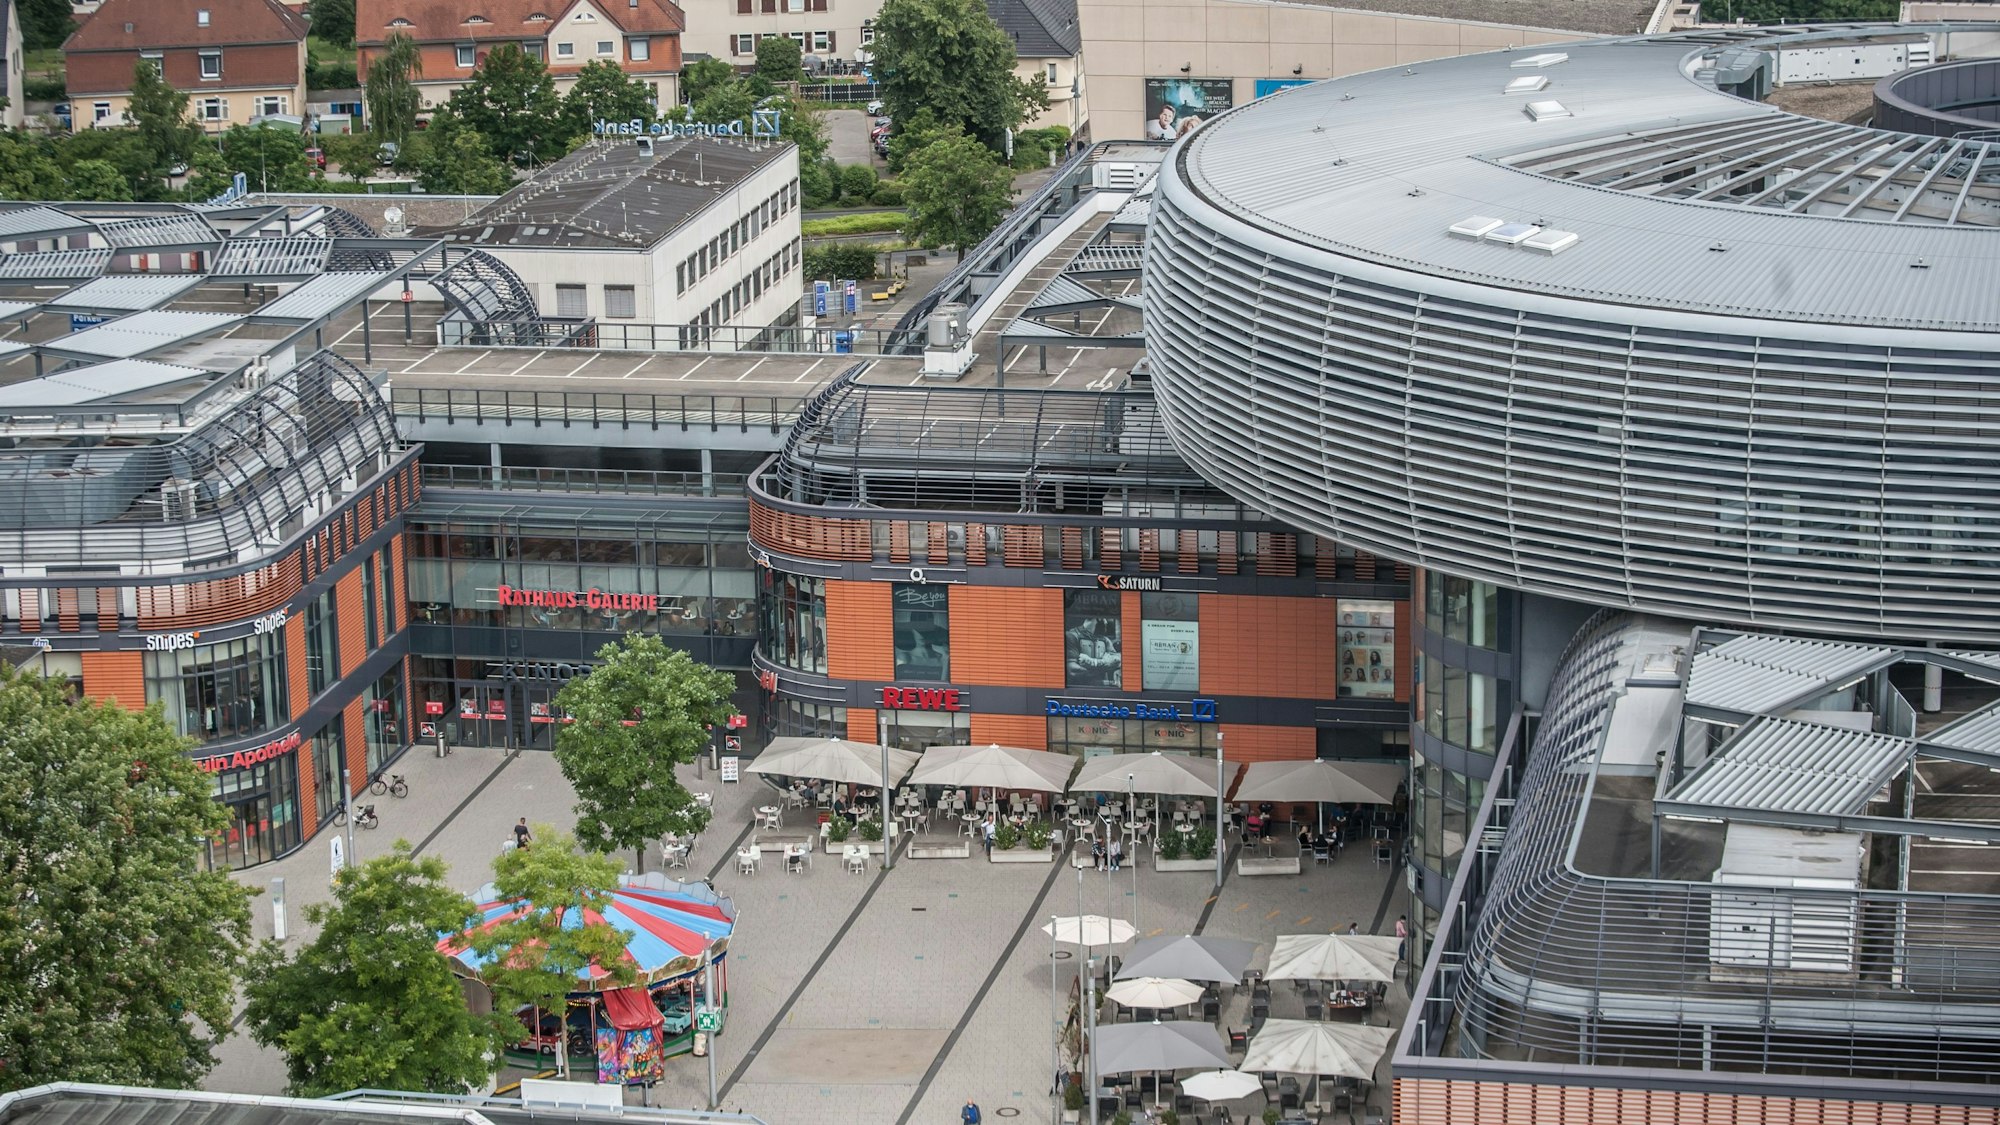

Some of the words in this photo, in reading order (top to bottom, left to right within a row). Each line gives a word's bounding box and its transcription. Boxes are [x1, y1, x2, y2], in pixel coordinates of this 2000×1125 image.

[1119, 576, 1160, 591] SATURN
[254, 608, 287, 635] snipes
[146, 631, 195, 653] snipes
[883, 687, 960, 711] REWE
[1047, 700, 1130, 719] Deutsche
[1136, 703, 1182, 720] Bank
[232, 732, 301, 769] Apotheke
